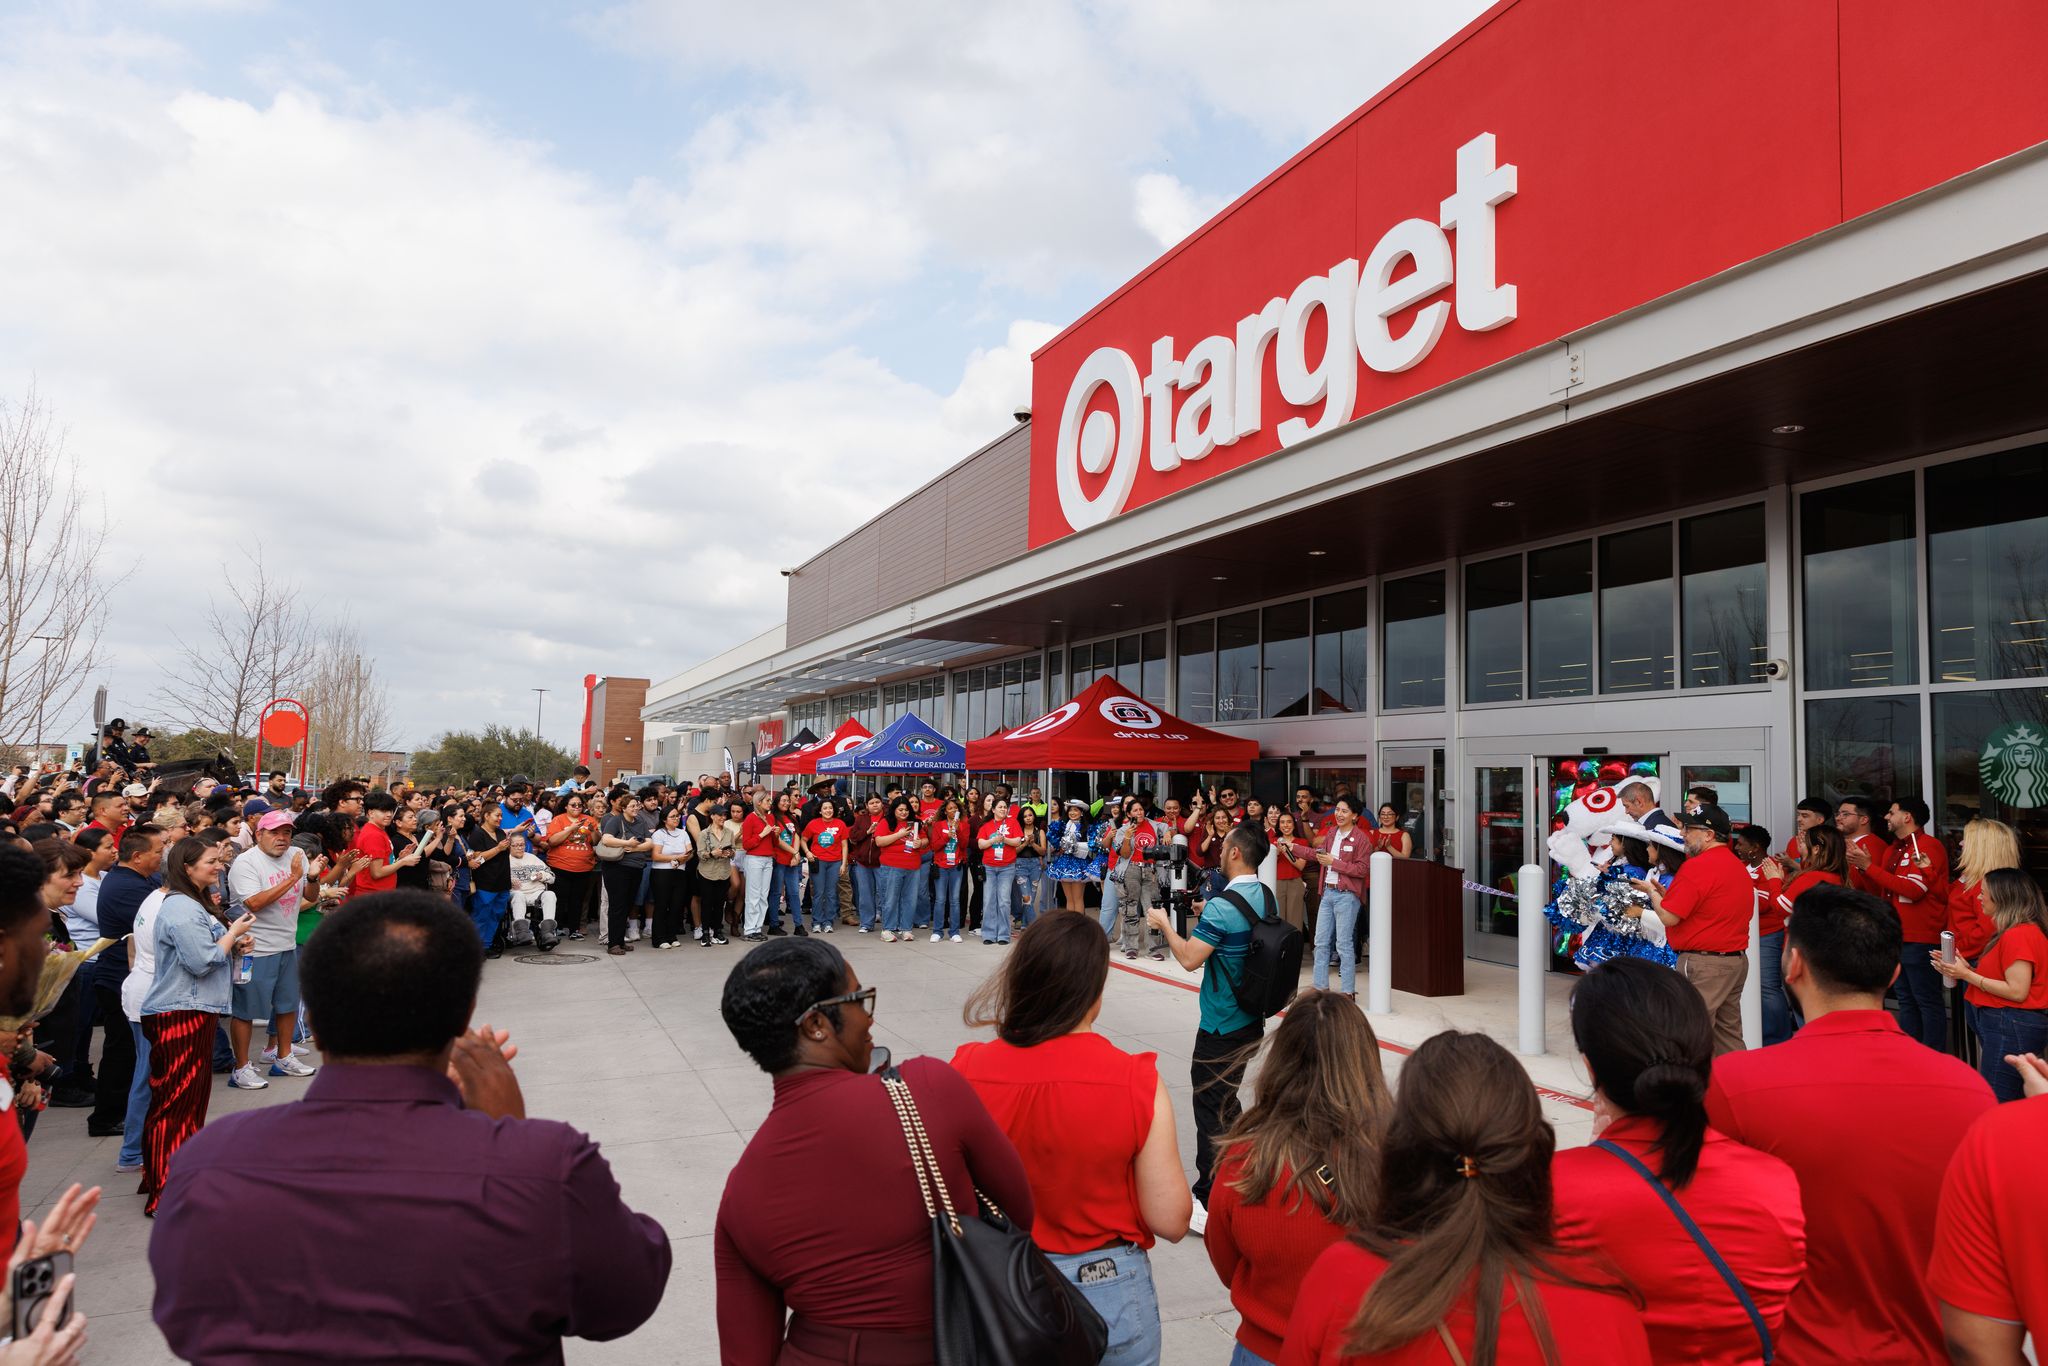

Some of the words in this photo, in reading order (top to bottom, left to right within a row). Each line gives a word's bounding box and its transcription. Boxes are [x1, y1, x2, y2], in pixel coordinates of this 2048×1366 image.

[1143, 131, 1518, 471] target
[1218, 698, 1234, 712] 655
[1113, 731, 1161, 740] drive
[869, 759, 913, 768] COMMUNITY
[915, 760, 960, 769] OPERATIONS
[1139, 838, 1149, 846] TX
